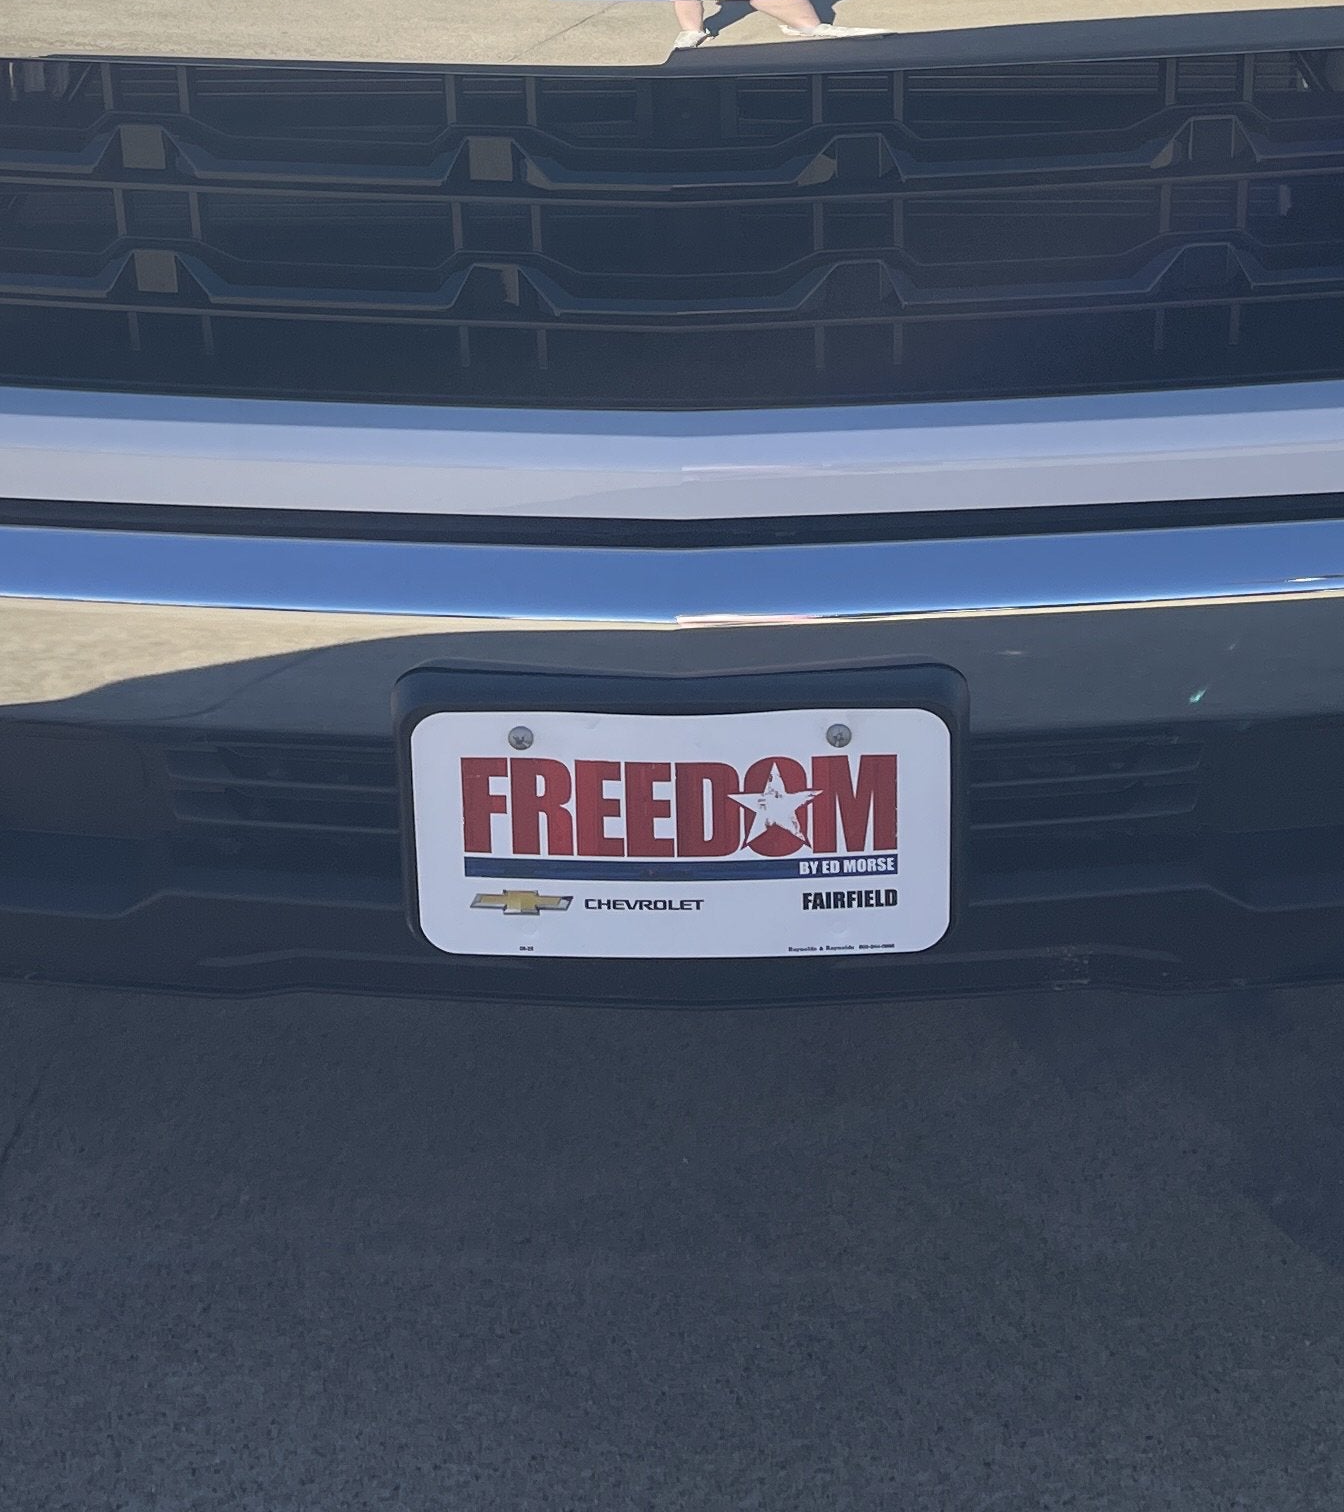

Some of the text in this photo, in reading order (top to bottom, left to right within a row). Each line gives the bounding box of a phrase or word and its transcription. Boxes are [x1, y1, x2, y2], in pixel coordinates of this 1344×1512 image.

[460, 754, 898, 857] FREEDOM
[799, 857, 895, 875] BY ED MORSE
[584, 898, 705, 911] CHEVROLET
[802, 889, 898, 910] FAIRFIELD
